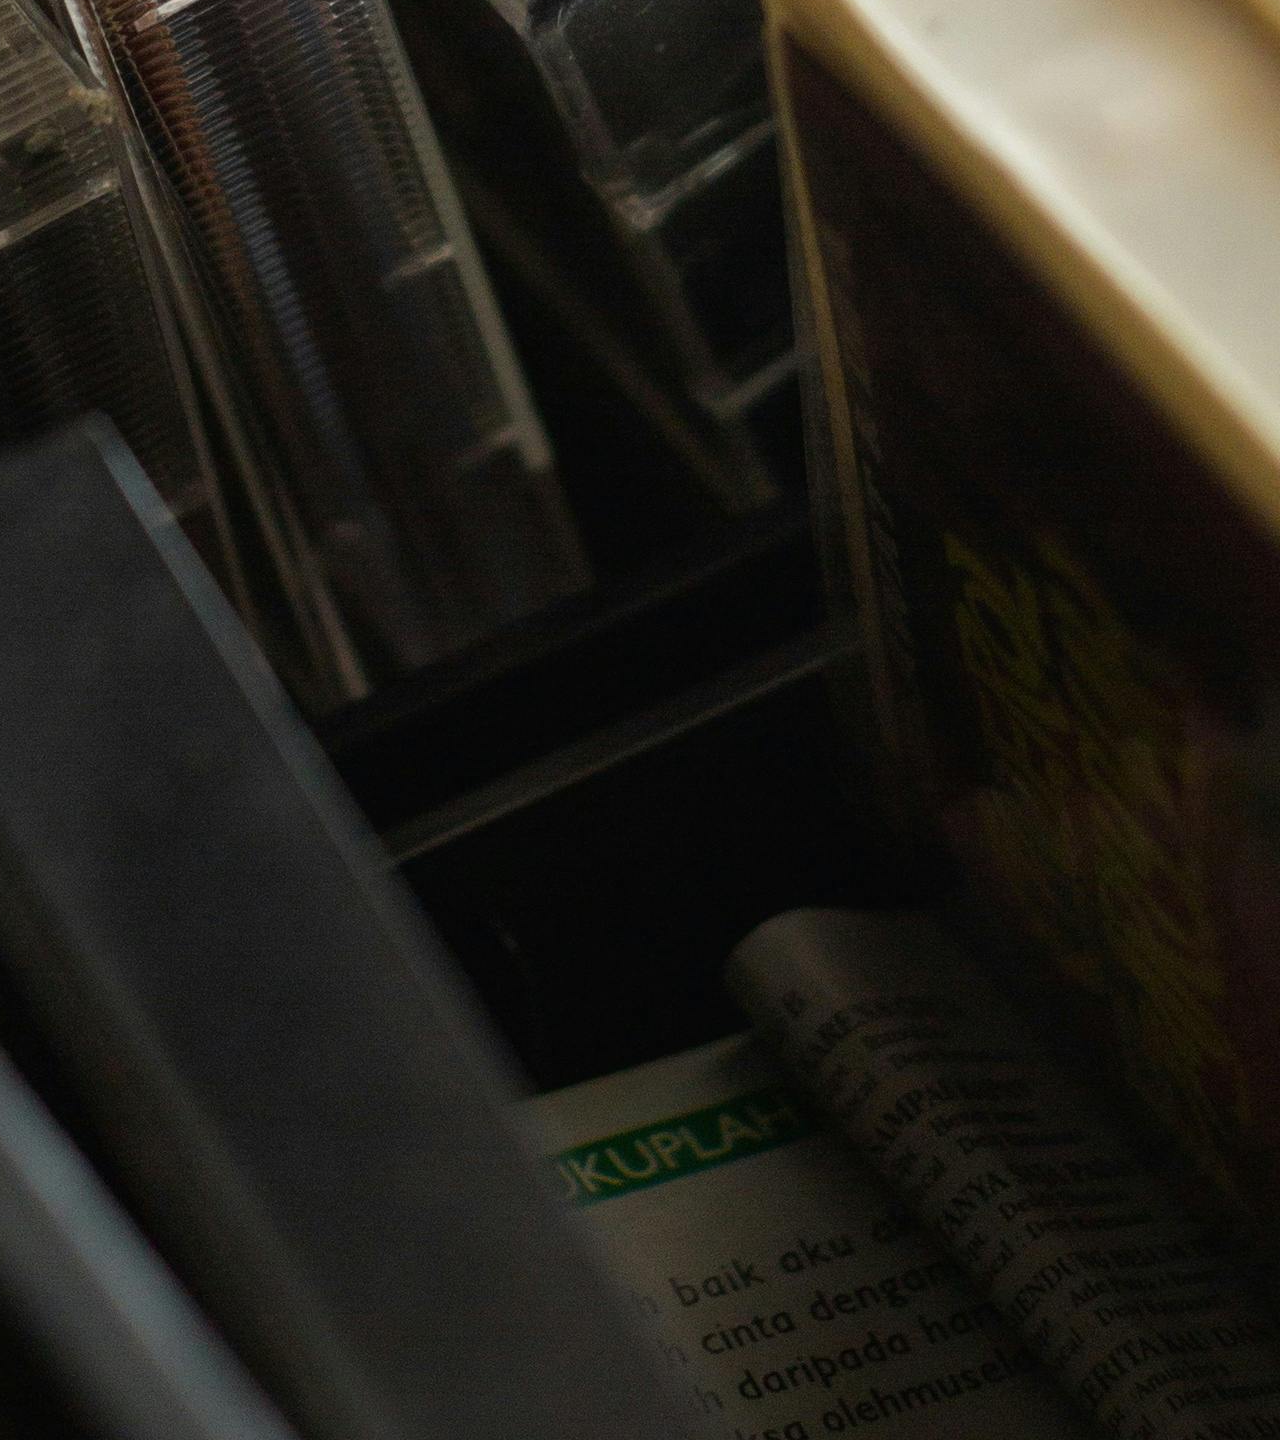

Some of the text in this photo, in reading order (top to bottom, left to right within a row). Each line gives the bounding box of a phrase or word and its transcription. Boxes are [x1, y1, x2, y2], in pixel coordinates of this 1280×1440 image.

[668, 1258, 766, 1309] baik
[777, 1232, 856, 1277] aku
[700, 1308, 797, 1358] cinta
[736, 1330, 912, 1403] daripada
[1080, 1332, 1162, 1407] ERITA
